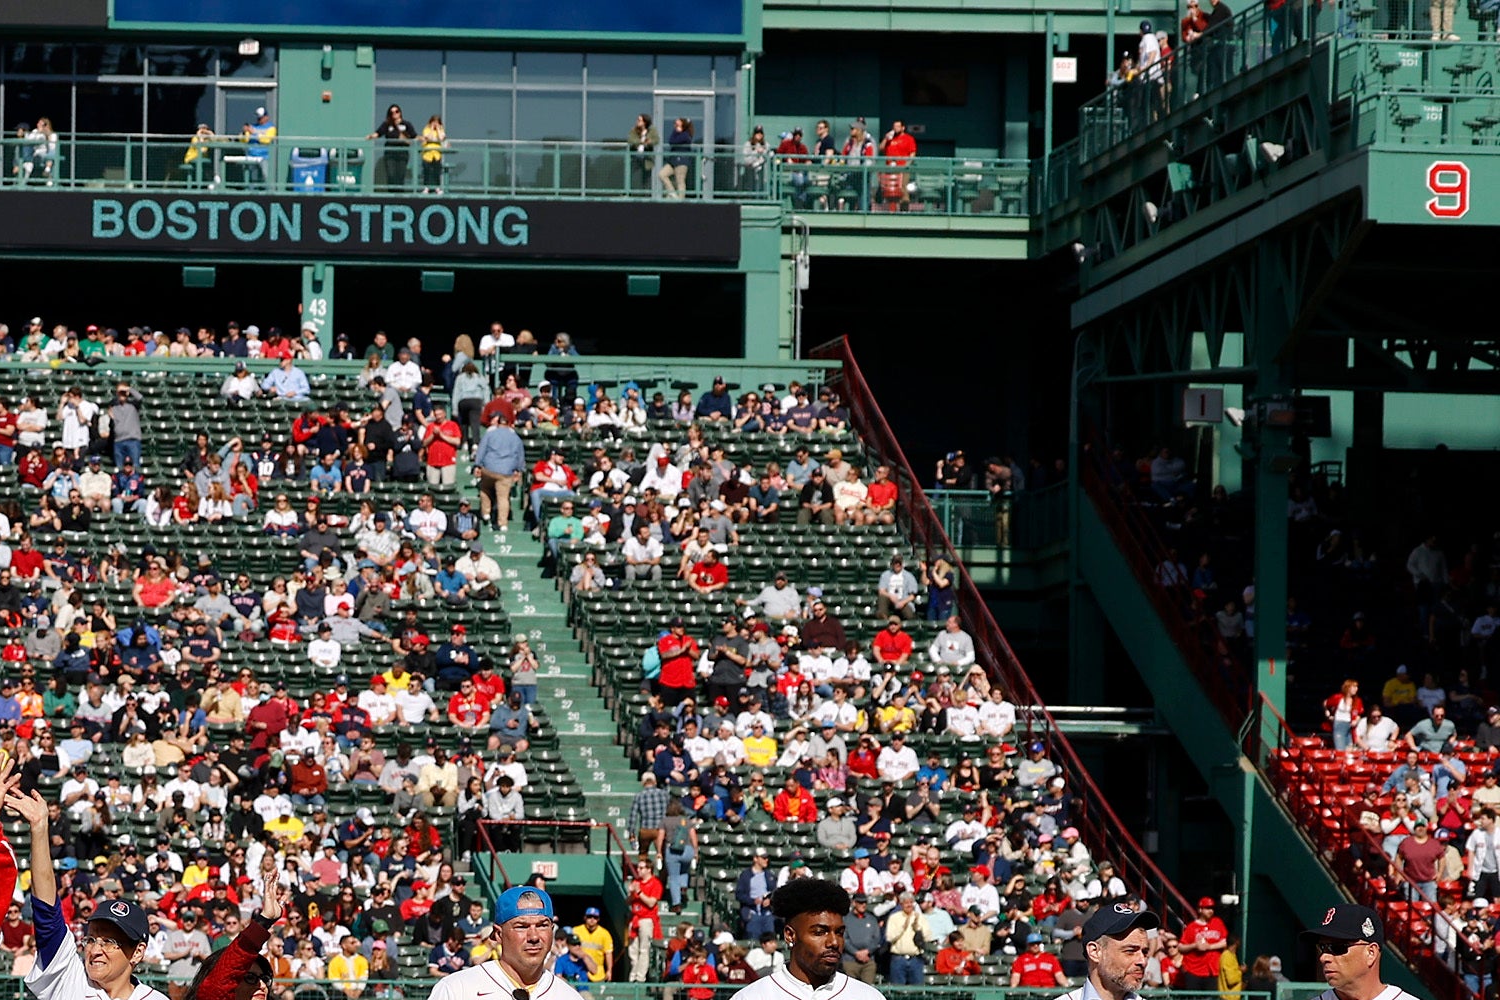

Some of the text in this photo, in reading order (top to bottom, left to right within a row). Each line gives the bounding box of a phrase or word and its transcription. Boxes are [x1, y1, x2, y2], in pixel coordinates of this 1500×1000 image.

[1426, 160, 1470, 218] 9
[92, 199, 529, 246] BOSTON STRONG
[309, 298, 327, 316] 43
